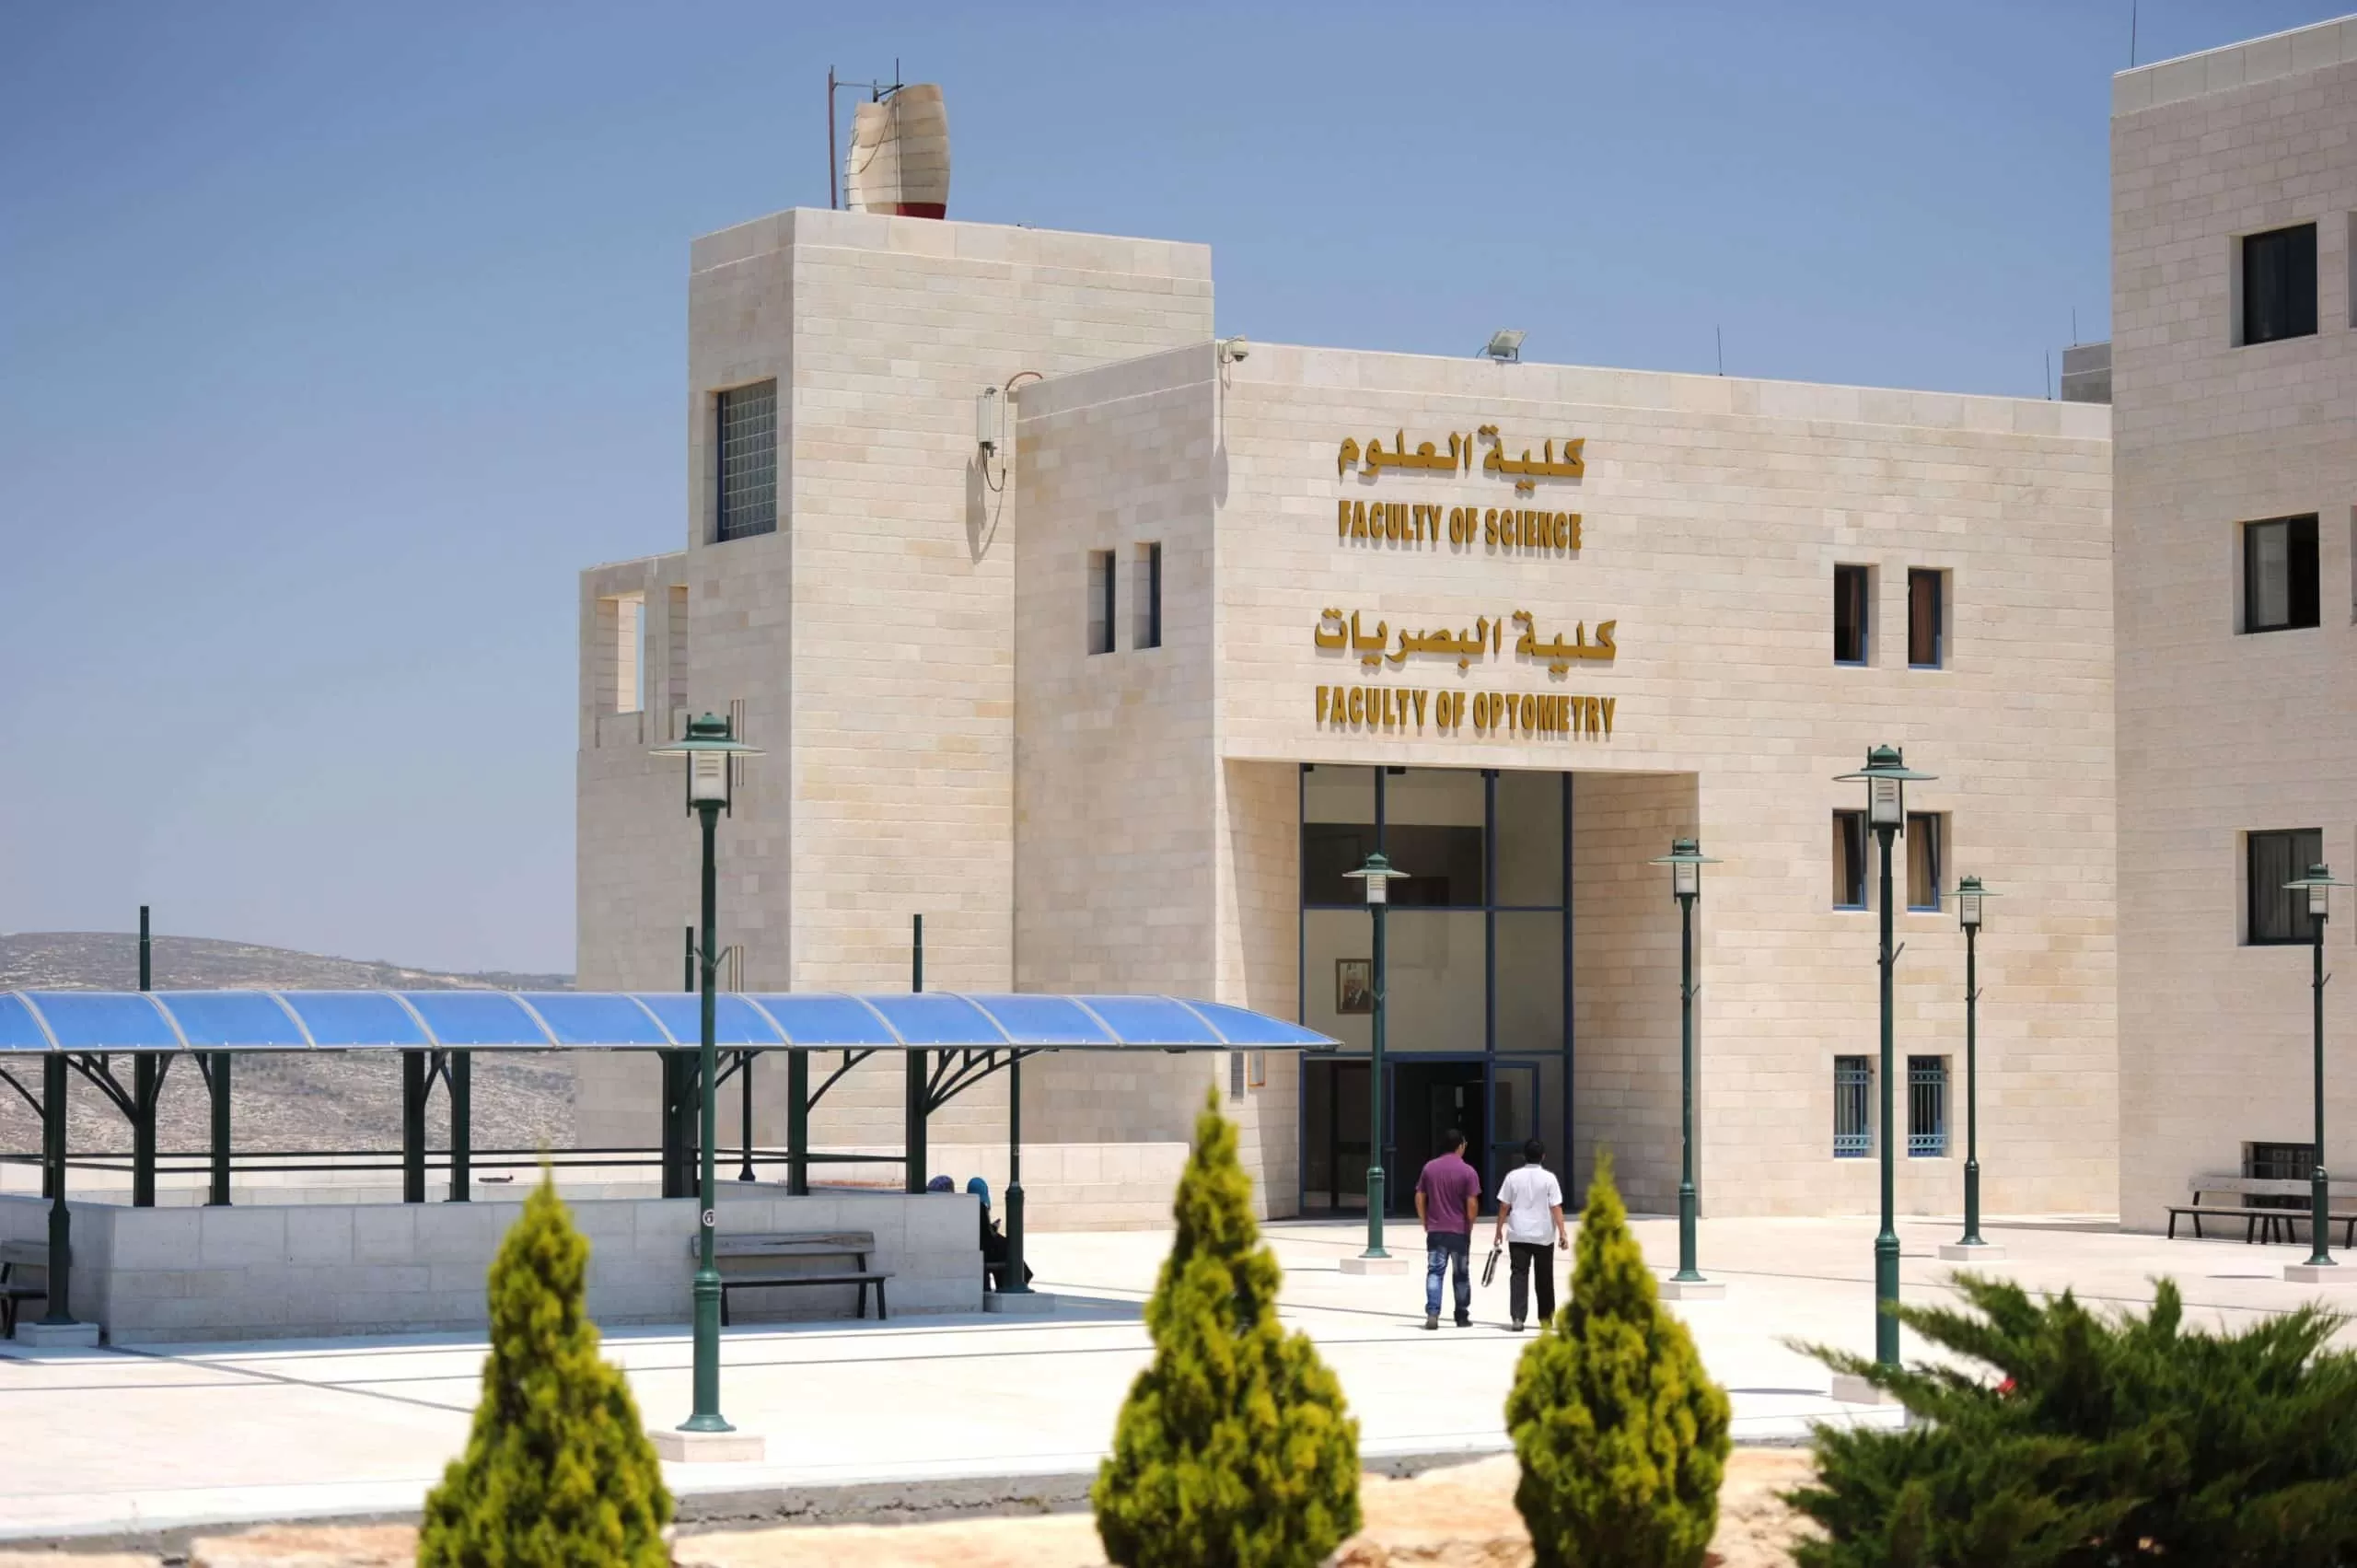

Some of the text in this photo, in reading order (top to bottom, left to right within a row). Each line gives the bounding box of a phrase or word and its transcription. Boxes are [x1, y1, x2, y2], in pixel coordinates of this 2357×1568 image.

[1338, 424, 1585, 491] كلية العلوم
[1339, 500, 1582, 551] FACULTY OF SCIENCE
[1315, 608, 1618, 674] كلية البصريات
[1315, 685, 1617, 734] FACULTY OF OPTOMETRY
